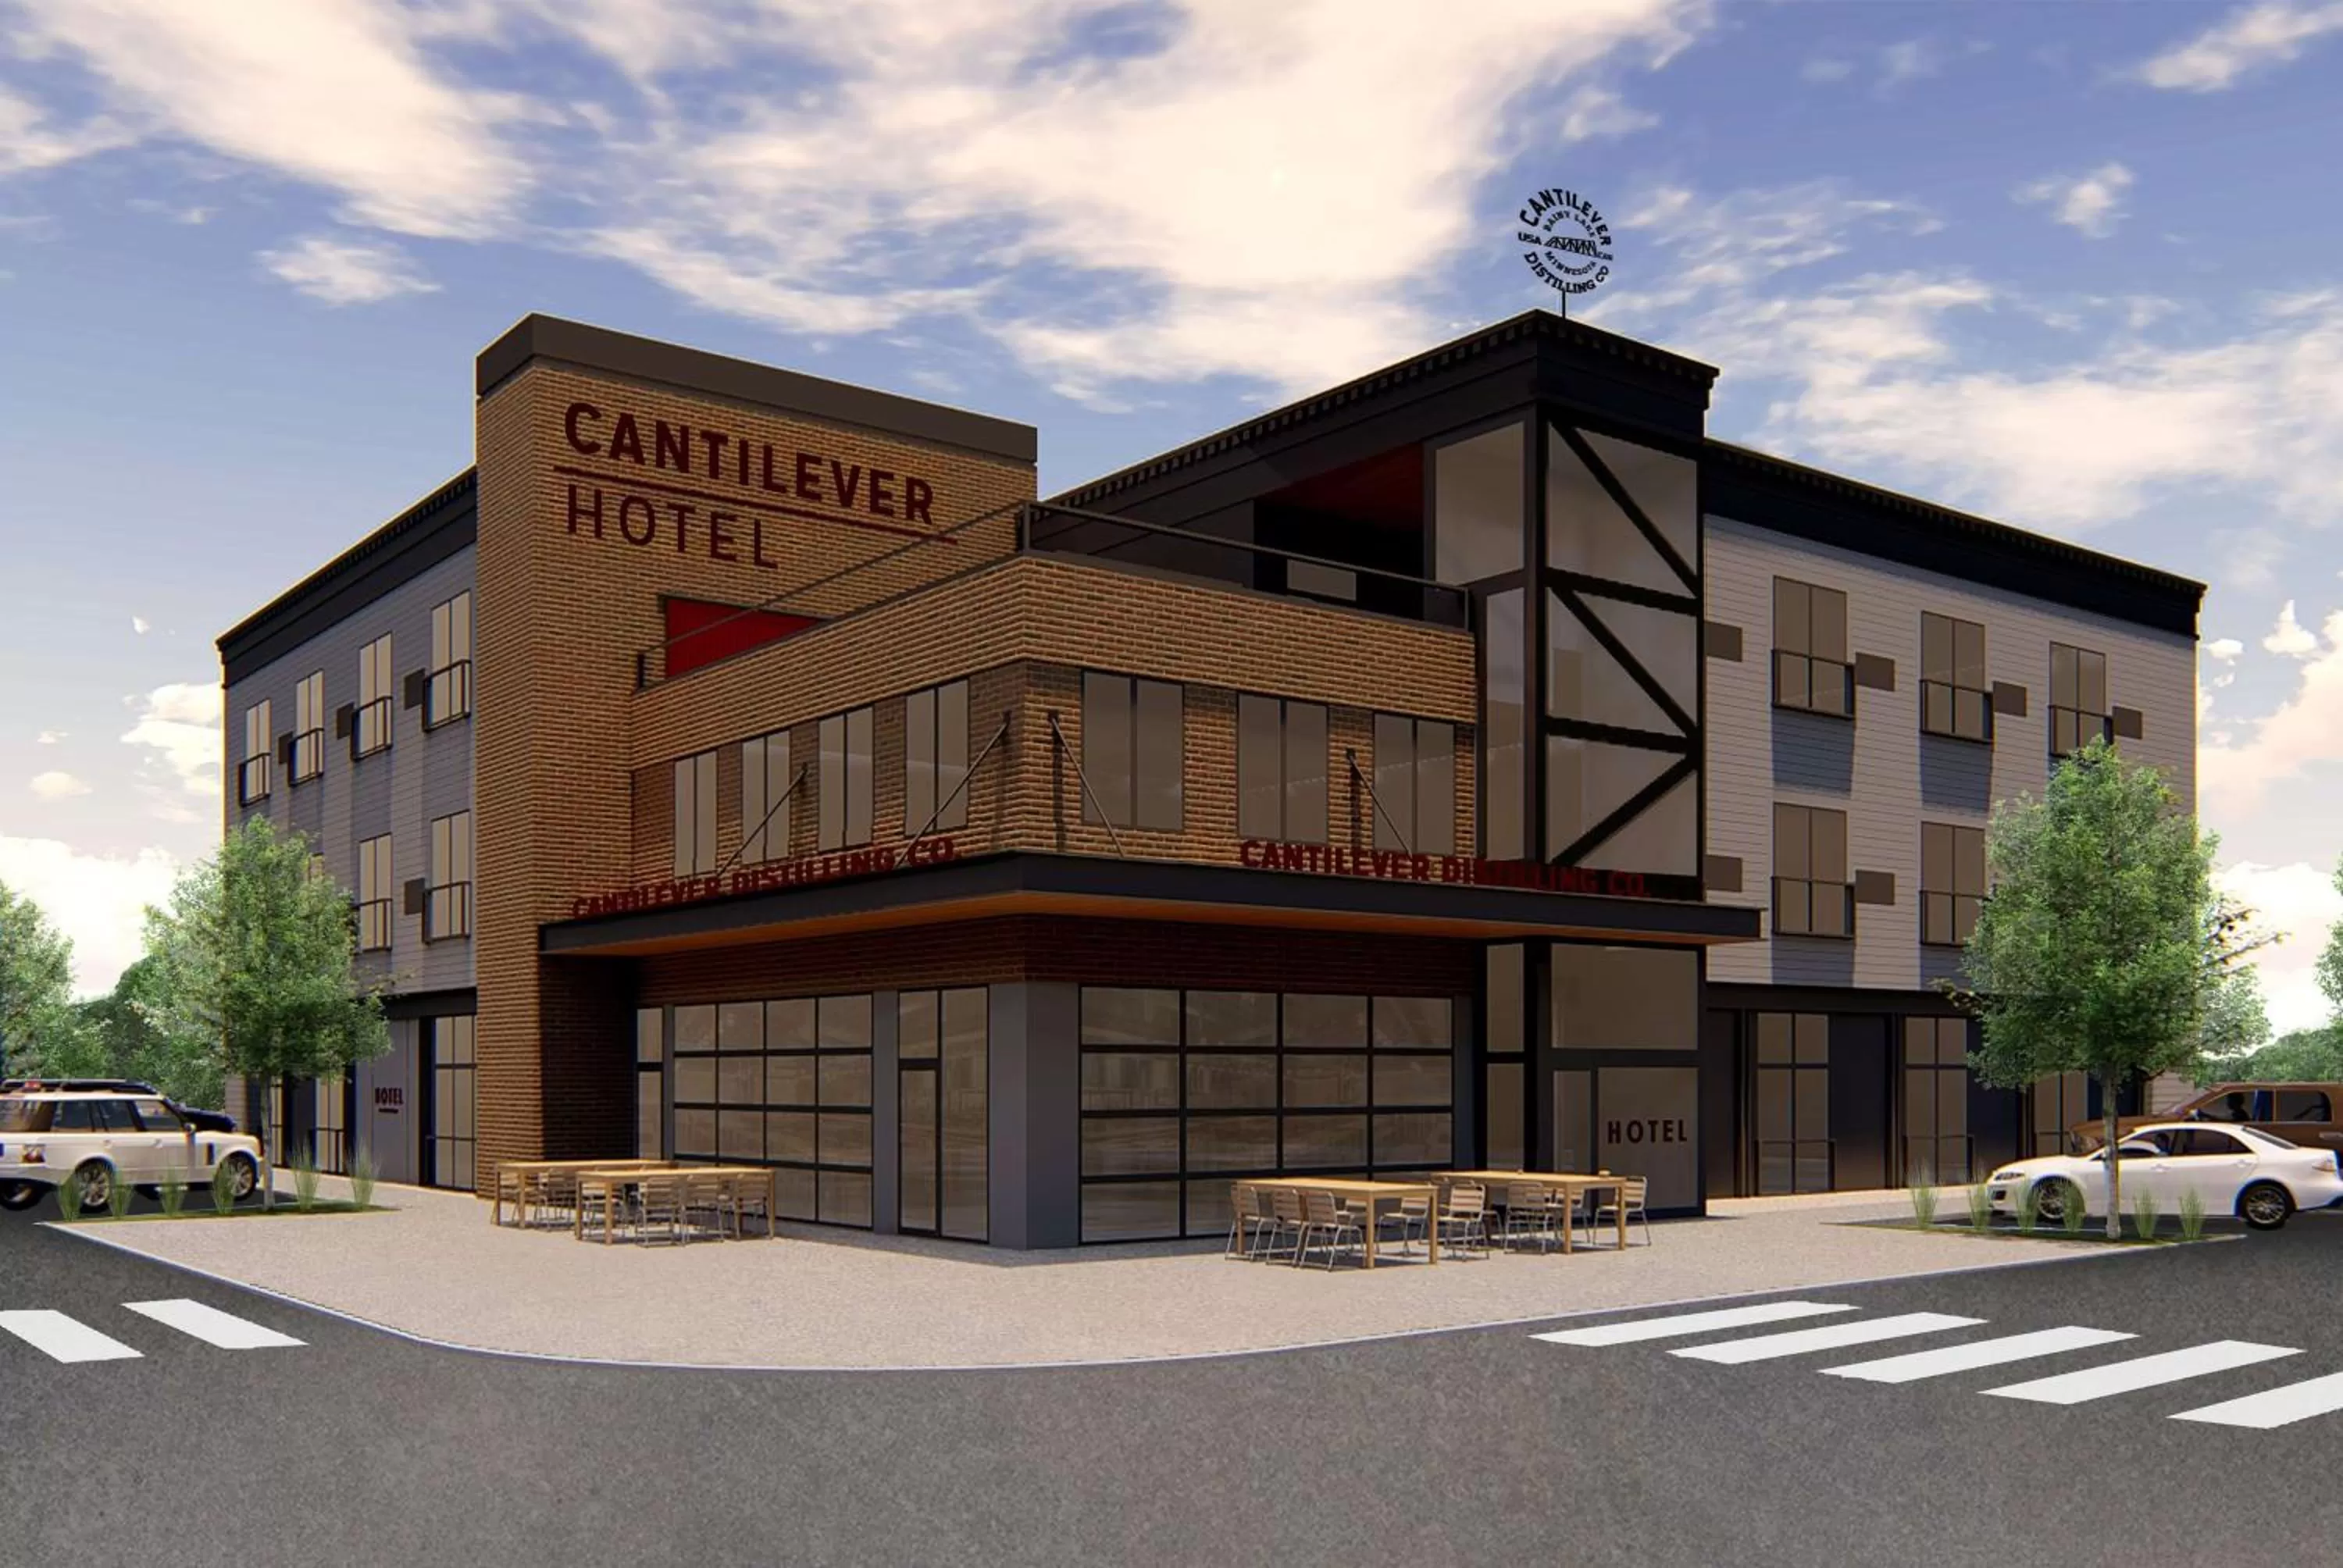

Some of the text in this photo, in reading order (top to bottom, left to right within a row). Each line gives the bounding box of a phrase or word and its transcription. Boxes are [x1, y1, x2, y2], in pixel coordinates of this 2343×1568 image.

[1517, 232, 1542, 246] USA
[1519, 187, 1611, 246] CANTILEVER
[1525, 251, 1609, 294] DISTILLING CO
[565, 401, 933, 526] CANTILEVER
[568, 483, 779, 569] HOTEL
[575, 877, 721, 919] CANTILEVER
[732, 848, 895, 893] DISTILLING
[1239, 839, 1431, 883] CANTILEVER
[1443, 856, 1599, 895] DILLING
[1607, 1119, 1688, 1144] HOTEL
